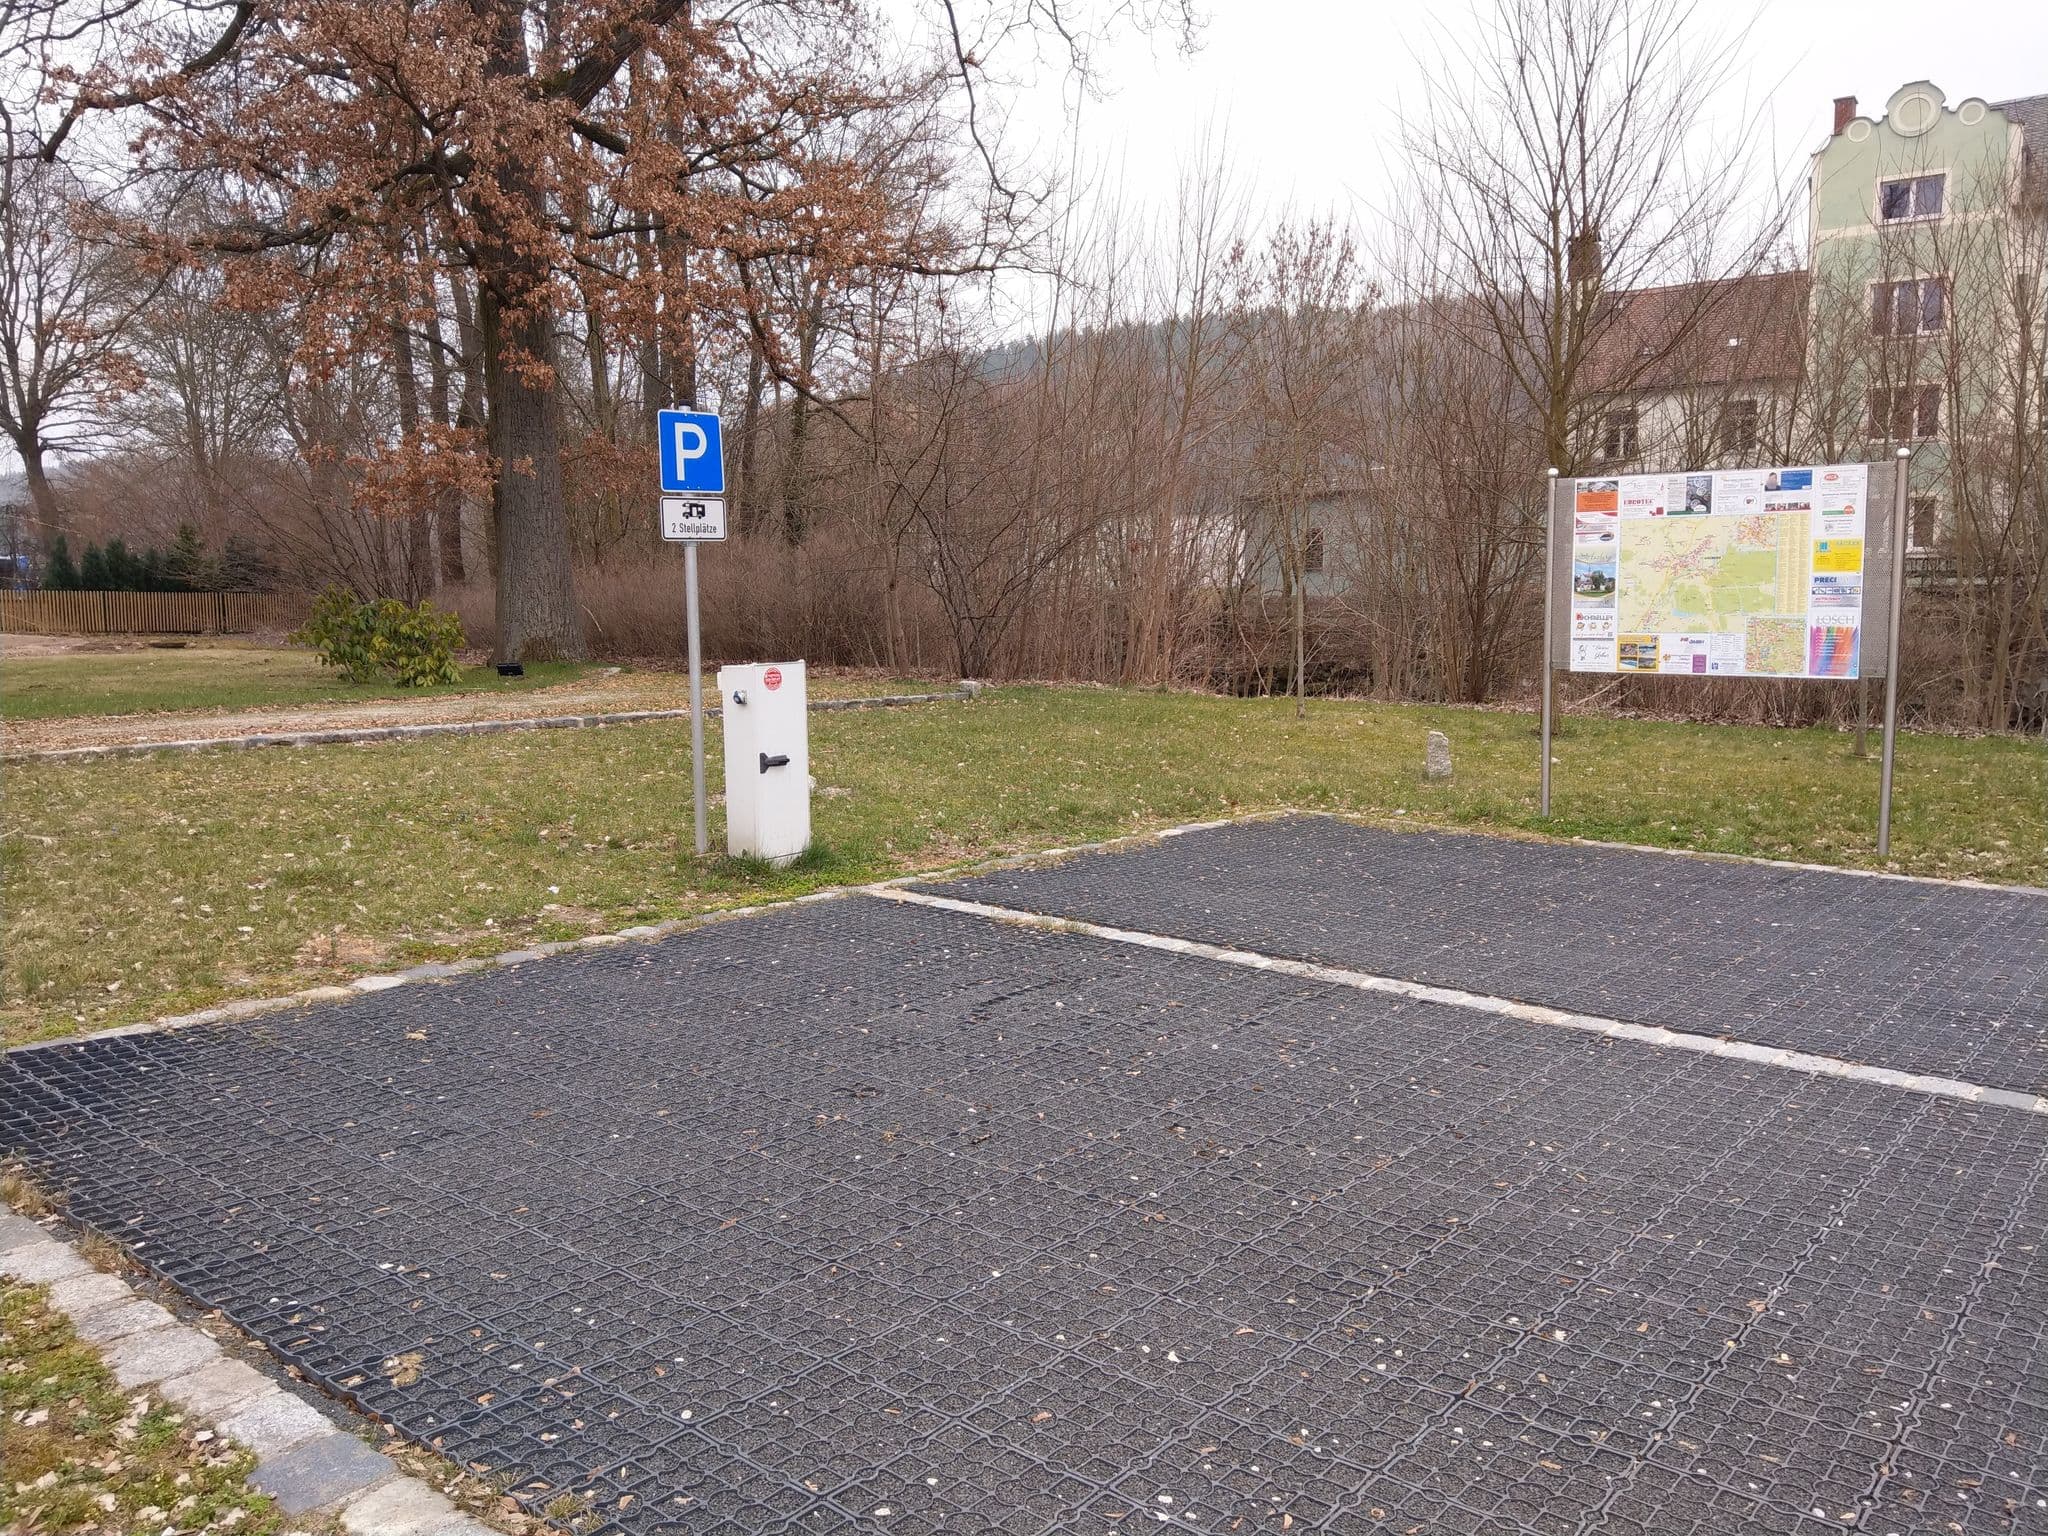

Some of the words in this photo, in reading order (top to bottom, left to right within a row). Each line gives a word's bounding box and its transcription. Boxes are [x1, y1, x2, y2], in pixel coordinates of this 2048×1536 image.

[674, 422, 707, 481] P
[672, 523, 677, 533] 2
[679, 523, 717, 535] Stellplätze
